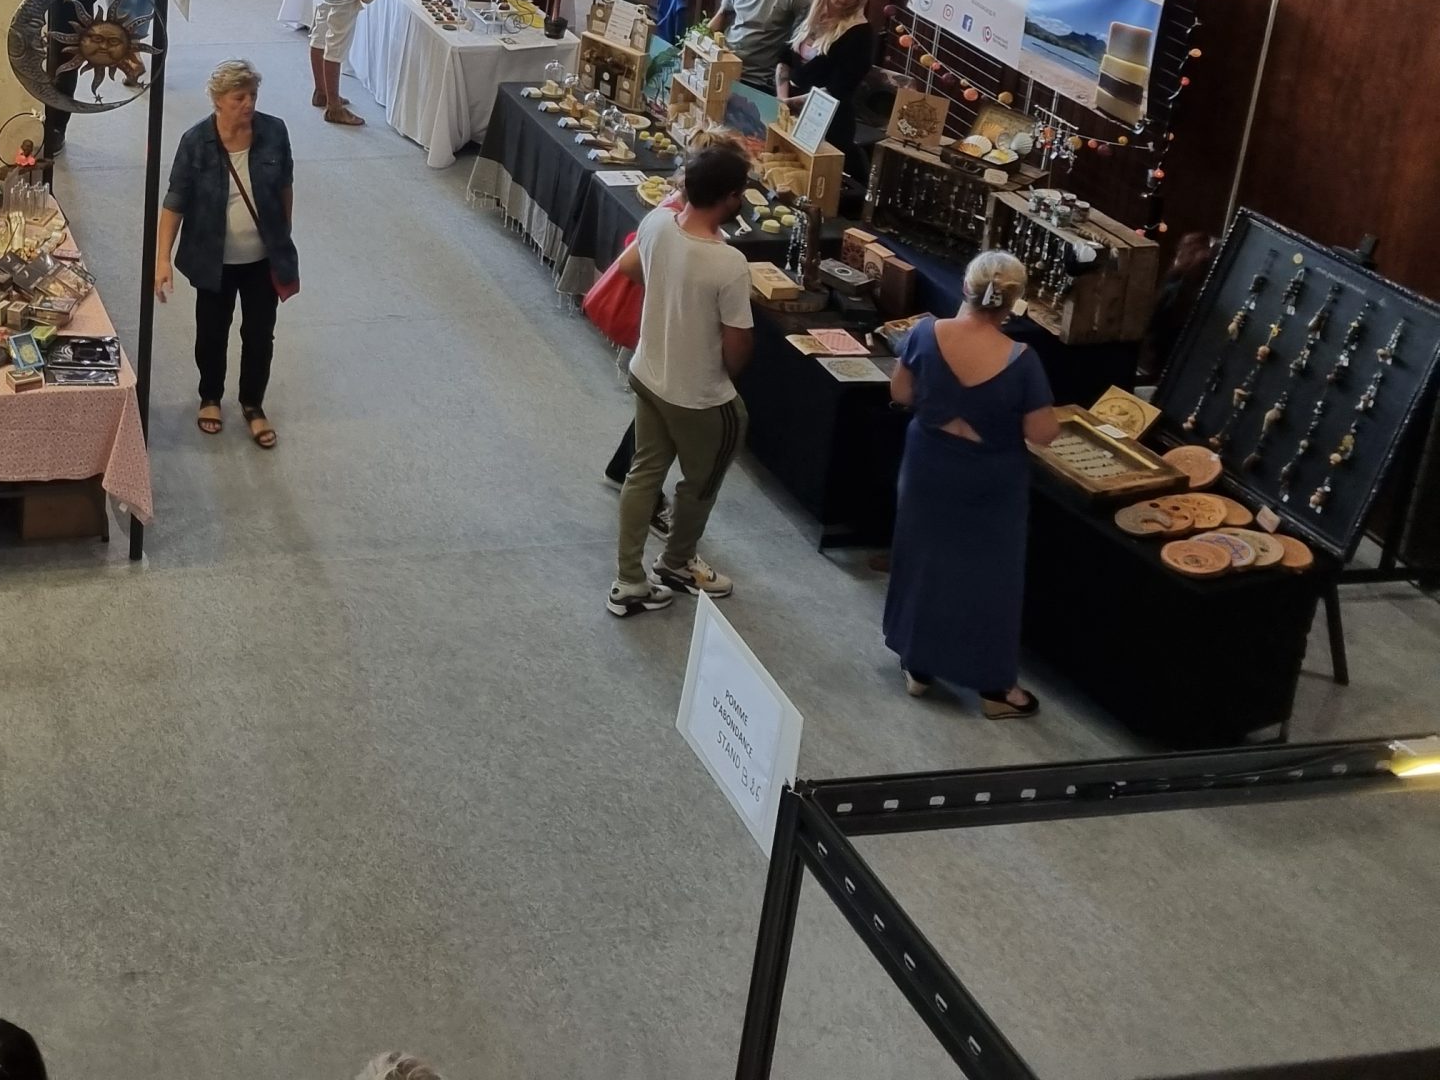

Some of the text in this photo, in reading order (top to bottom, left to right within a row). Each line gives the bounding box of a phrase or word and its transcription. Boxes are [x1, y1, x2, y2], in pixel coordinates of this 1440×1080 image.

[725, 689, 748, 726] POMME
[713, 696, 753, 759] D'ABONDANCE
[717, 730, 741, 769] STAND
